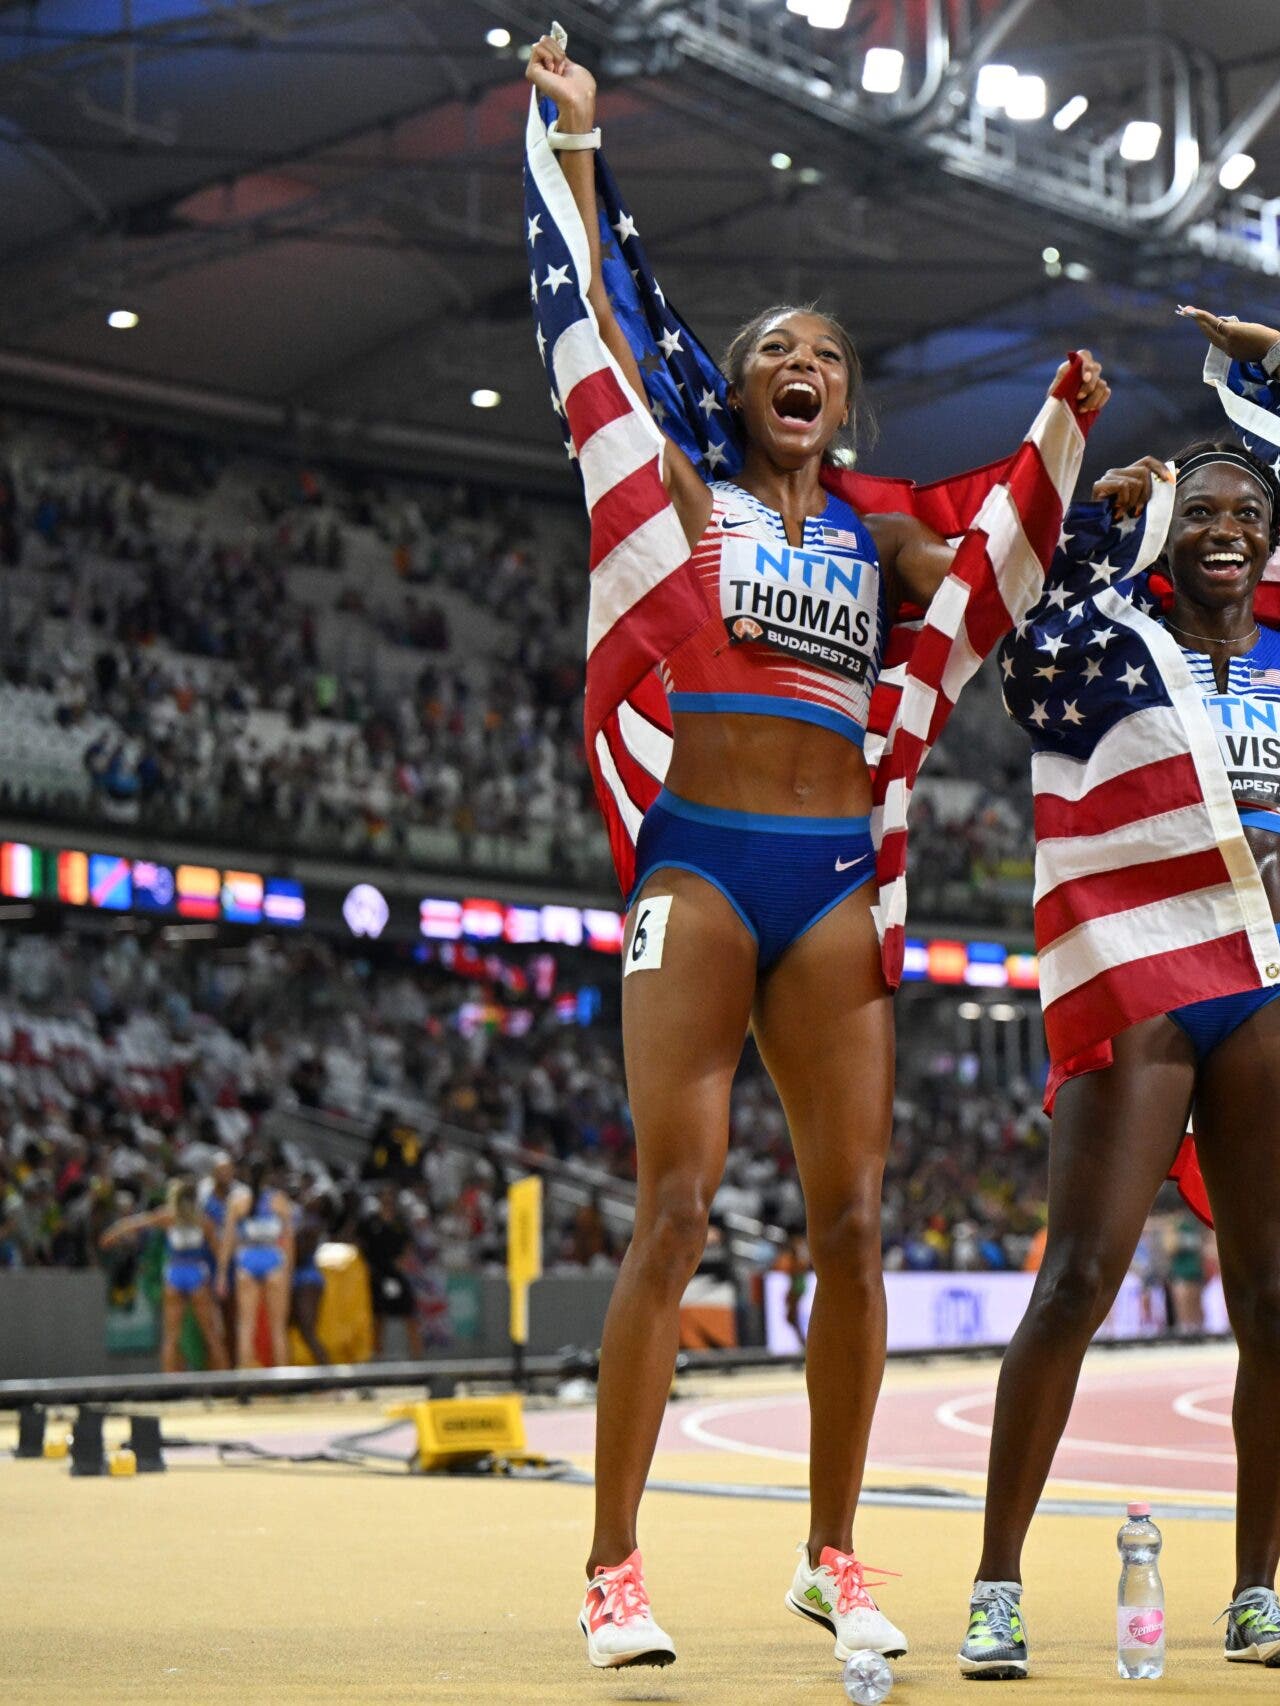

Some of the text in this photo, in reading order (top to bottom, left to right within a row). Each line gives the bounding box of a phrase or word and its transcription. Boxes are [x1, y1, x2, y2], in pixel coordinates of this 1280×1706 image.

[755, 543, 862, 600] NTN
[729, 580, 870, 647] THOMAS
[767, 630, 861, 673] BUDAPEST 23
[1202, 697, 1278, 734] TN
[1232, 779, 1280, 794] APEST
[632, 909, 648, 961] 6
